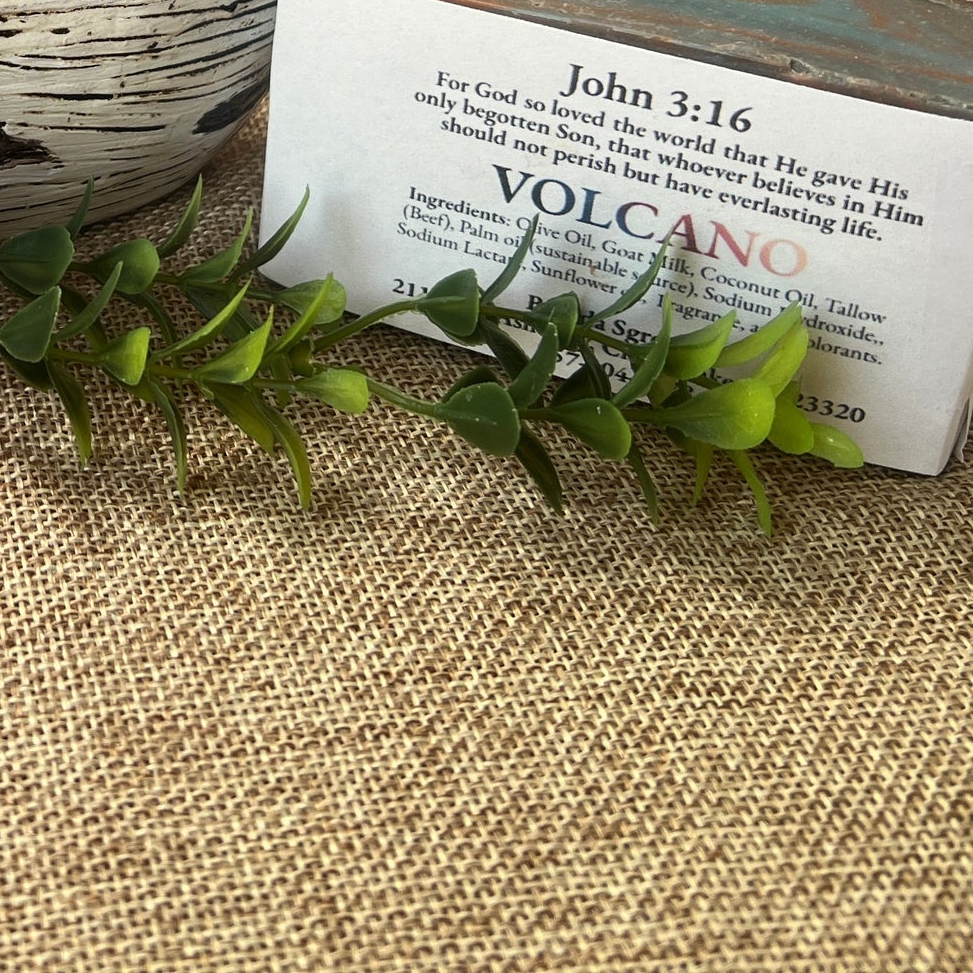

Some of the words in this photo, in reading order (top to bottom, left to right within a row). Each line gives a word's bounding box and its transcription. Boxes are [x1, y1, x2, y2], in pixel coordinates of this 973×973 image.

[435, 70, 470, 93] For
[474, 81, 518, 105] God
[523, 98, 546, 112] so
[550, 99, 605, 127] loved
[613, 117, 647, 138] the
[653, 130, 716, 155] world
[723, 144, 769, 168] that
[774, 154, 808, 177] He
[811, 169, 862, 191] gave
[867, 177, 909, 201] His
[559, 63, 653, 110] John
[665, 90, 754, 133] 3:16
[414, 89, 457, 114] only
[462, 98, 550, 135] begotten
[555, 123, 601, 150] Son,
[607, 138, 651, 161] that
[657, 153, 748, 184] whoever
[751, 172, 836, 206] believes
[842, 194, 865, 214] in
[872, 200, 924, 226] Him
[440, 117, 507, 146] should
[512, 139, 548, 157] not
[552, 148, 617, 174] perish
[622, 162, 659, 186] but
[664, 171, 713, 199] have
[718, 191, 837, 234] everlasting
[841, 217, 882, 241] life.
[396, 221, 458, 251] Sodium
[464, 241, 527, 271] Lacta,
[531, 260, 618, 294] Sunflower
[403, 204, 455, 231] (Beef),
[458, 218, 499, 243] Palm
[529, 238, 627, 277] (sustainable
[631, 270, 698, 298] surce),
[703, 286, 772, 316] Sodium
[409, 186, 511, 226] Ingredients:
[515, 217, 560, 240] Oive
[564, 229, 596, 250] Oil,
[602, 239, 645, 262] Goat
[700, 266, 780, 299] Coconut
[785, 289, 818, 310] Oil,
[825, 297, 887, 324] Tallow
[491, 164, 808, 277] VOLCANO
[807, 335, 882, 365] olorants.
